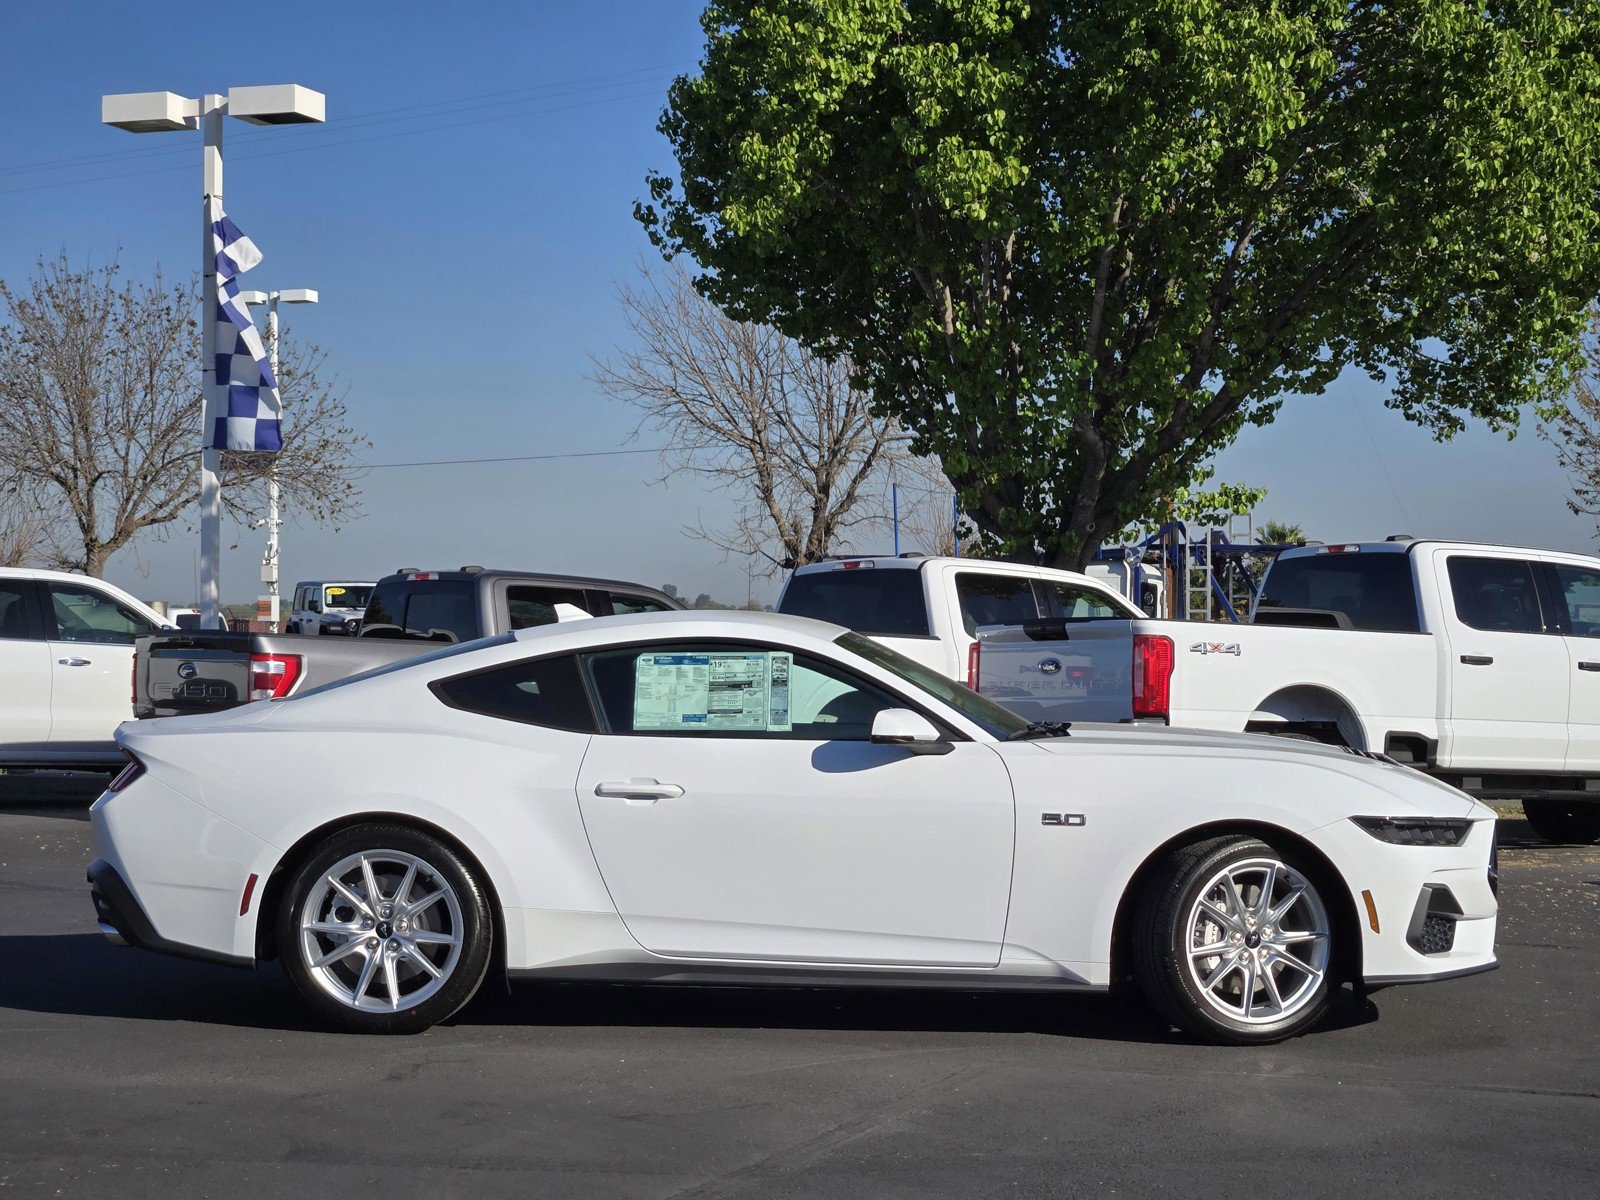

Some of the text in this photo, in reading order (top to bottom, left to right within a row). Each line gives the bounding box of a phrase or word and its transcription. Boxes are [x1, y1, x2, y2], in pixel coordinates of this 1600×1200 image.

[153, 681, 227, 698] F-150
[986, 680, 1057, 692] SUPER
[1041, 812, 1087, 826] 5.0
